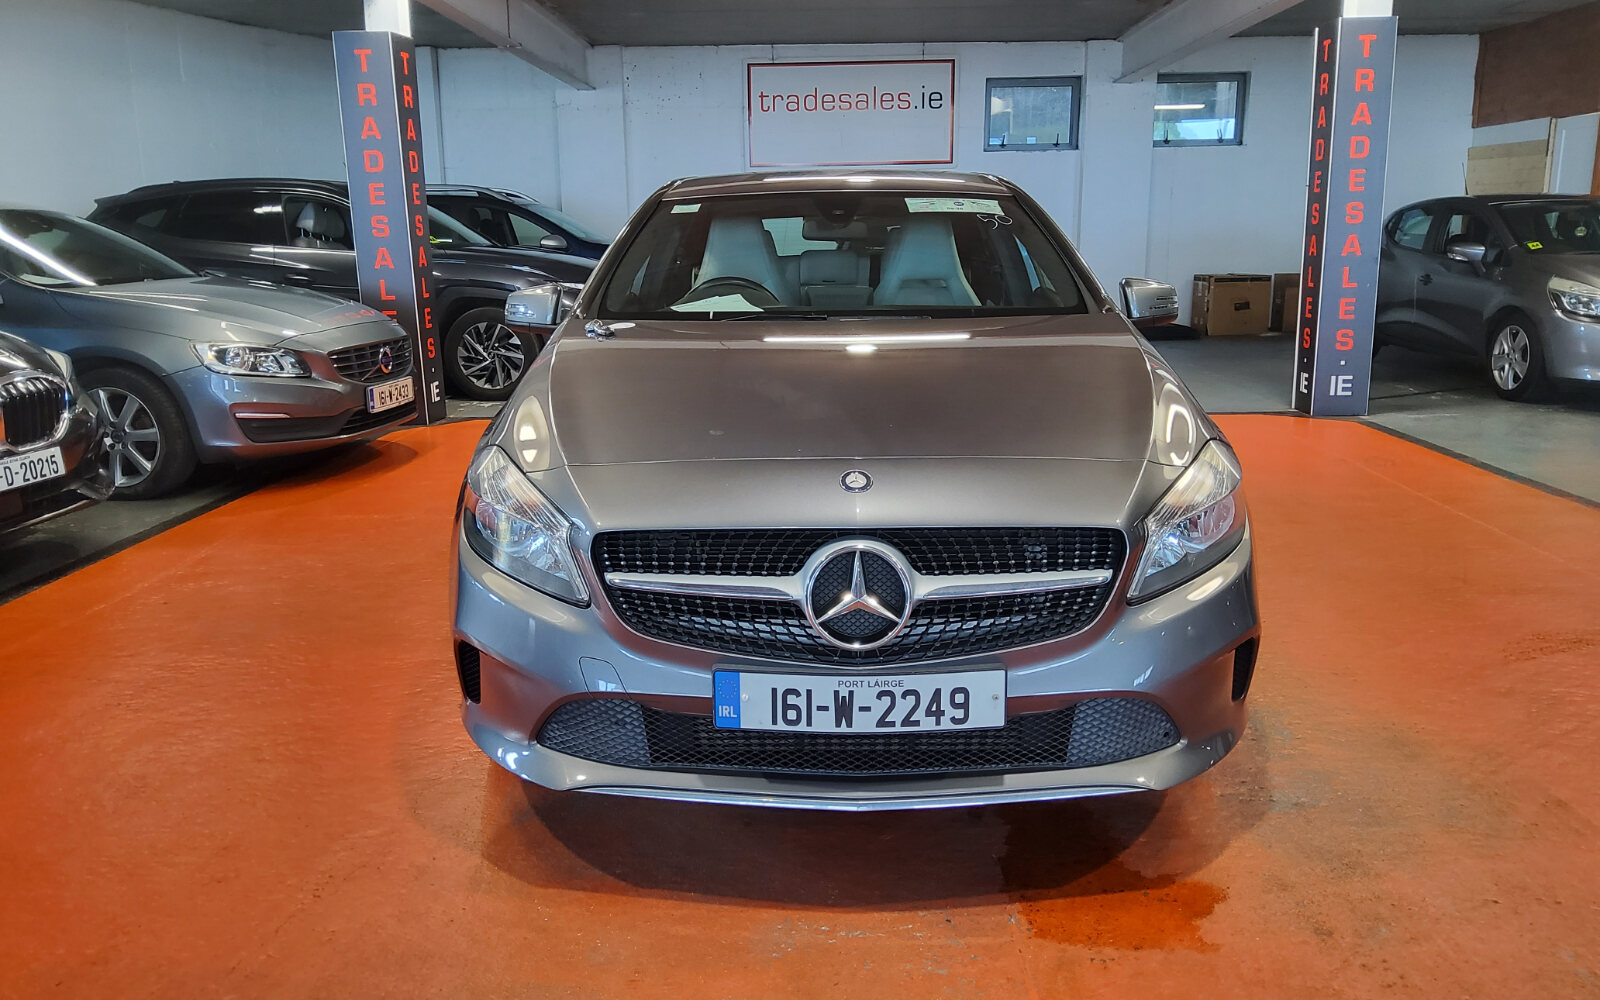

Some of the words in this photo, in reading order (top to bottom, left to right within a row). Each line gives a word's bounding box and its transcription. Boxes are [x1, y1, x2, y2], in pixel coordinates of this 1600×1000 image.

[758, 85, 944, 113] tradesales.ie
[976, 214, 1013, 229] 50
[378, 383, 409, 406] 161-W-2433
[838, 680, 864, 688] PORT
[867, 679, 905, 688] LÁIRGE
[718, 705, 738, 718] IRL
[771, 687, 971, 728] 161-W-2249
